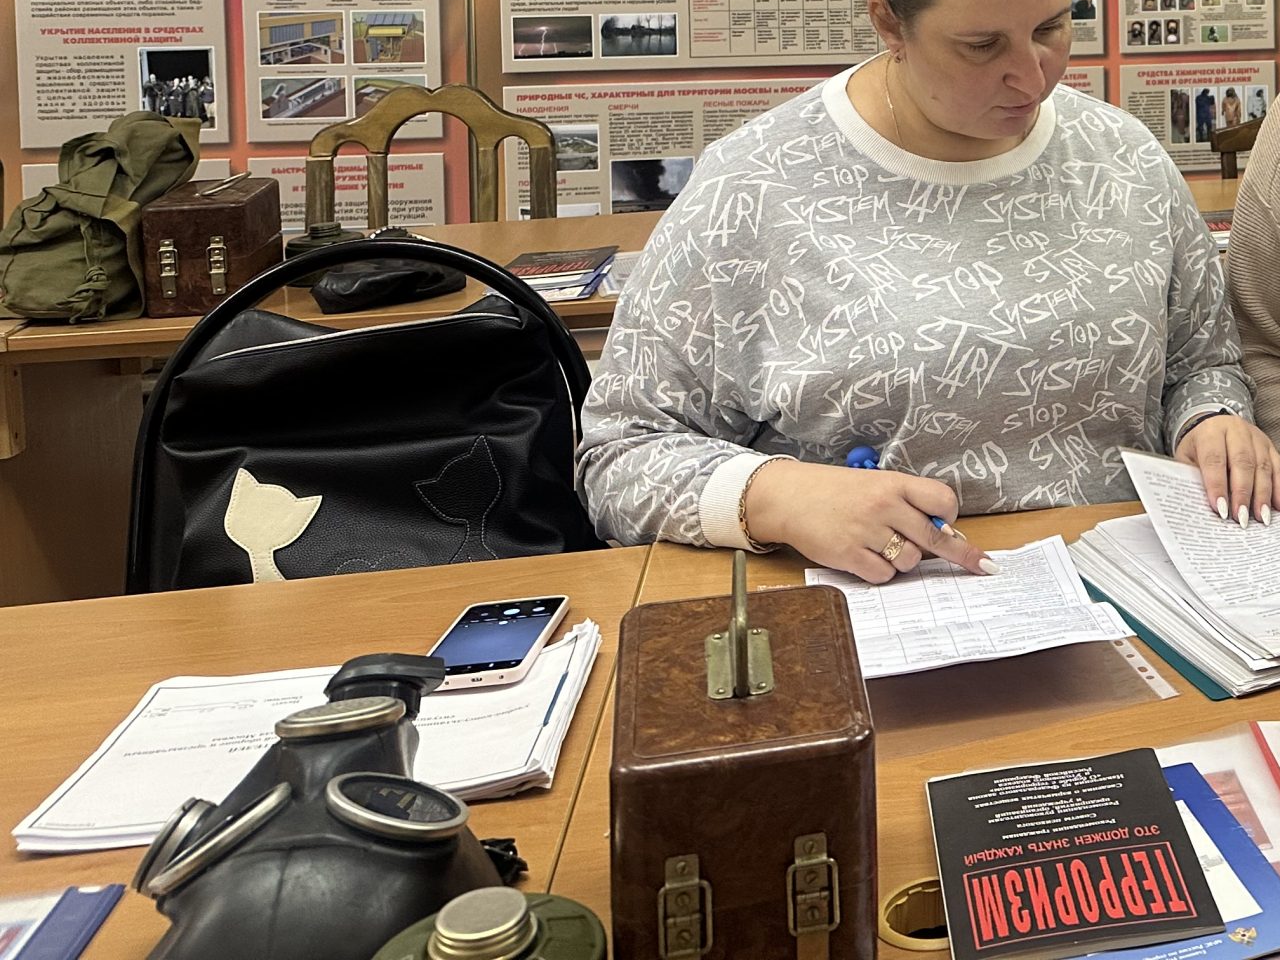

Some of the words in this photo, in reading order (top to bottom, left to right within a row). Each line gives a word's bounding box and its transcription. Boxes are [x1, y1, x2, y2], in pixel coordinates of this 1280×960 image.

[1175, 68, 1226, 76] ХИМИЧЕСКОЙ
[1214, 76, 1252, 84] ДЫХАНИЯ
[516, 92, 573, 102] ПРИРОДНЫЕ
[575, 92, 590, 102] ЧС,
[591, 91, 656, 100] ХАРАКТЕРНЫЕ
[657, 90, 675, 98] ДЛЯ
[678, 88, 732, 97] ТЕРРИТОРИИ
[734, 87, 772, 95] МОСКВЫ
[516, 105, 570, 113] НАВОДНЕНИЯ
[608, 103, 640, 111] СМЕРЧИ
[703, 100, 735, 108] ЛЕСНЫЕ
[1058, 108, 1123, 151] STOP
[813, 164, 869, 197] STOP
[1061, 160, 1154, 220] START
[774, 191, 896, 233] SYSTEM
[974, 191, 1080, 233] SYSTEM
[788, 230, 862, 265] STOP
[866, 226, 961, 263] SYSTEM
[987, 231, 1049, 255] STOP
[1058, 221, 1134, 251] SYSTEM
[912, 261, 1003, 309] STOP
[1104, 259, 1166, 305] STOP
[732, 276, 806, 351] STOP
[983, 283, 1096, 339] SYSTEM
[787, 292, 898, 371] SYSTEM
[1048, 320, 1100, 359] STOP
[848, 332, 905, 371] STOP
[914, 315, 1034, 399] START
[820, 361, 926, 422] SYSTEM
[1002, 354, 1114, 399] SYSTEM
[1001, 403, 1067, 433] STOP
[1082, 783, 1123, 792] Сведения
[1057, 800, 1120, 813] Рекомендации
[1064, 813, 1097, 823] Советы
[1002, 828, 1050, 840] гражданам
[1016, 819, 1061, 828] психолога
[1053, 819, 1116, 833] Рекомендации
[1074, 828, 1129, 846] ДОЛЖЕН
[1134, 824, 1160, 837] ЭТО
[963, 845, 1023, 866] КАЖДЫЙ
[1028, 839, 1070, 853] ЗНАТЬ
[972, 849, 1188, 941] ТЕРРОРИЗМ
